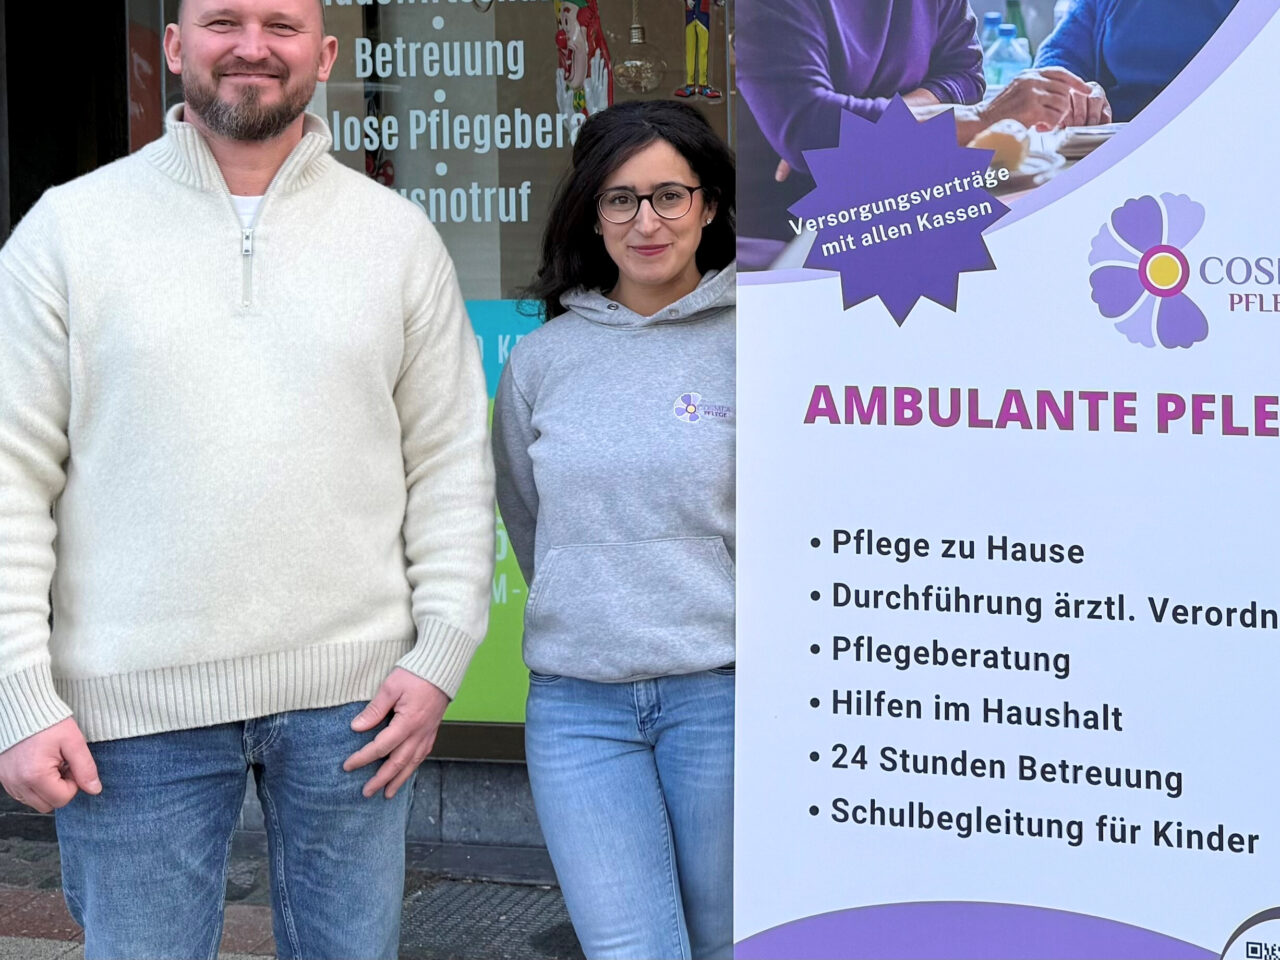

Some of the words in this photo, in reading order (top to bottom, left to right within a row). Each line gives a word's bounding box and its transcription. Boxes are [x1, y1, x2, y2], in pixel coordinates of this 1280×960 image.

[355, 36, 525, 80] Betreuung
[409, 107, 587, 153] Pflegebera
[400, 181, 531, 223] snotruf
[788, 167, 1010, 236] Versorgungsverträge
[821, 232, 857, 257] mit
[861, 221, 913, 247] allen
[915, 200, 993, 231] Kassen
[803, 384, 1138, 433] AMBULANTE
[832, 528, 930, 561] Pflege
[941, 539, 976, 560] zu
[987, 534, 1085, 565] Hause
[832, 582, 1042, 624] Durchführung
[1054, 591, 1135, 622] ärztl.
[832, 635, 1071, 680] Pflegeberatung
[832, 689, 922, 721] Hilfen
[934, 693, 971, 723] im
[982, 697, 1124, 732] Haushalt
[831, 743, 868, 771] 24
[879, 746, 1006, 780] Stunden
[1018, 754, 1184, 799] Betreuung
[831, 797, 1084, 848] Schulbegleitung
[1095, 814, 1142, 845] für
[1153, 819, 1260, 855] Kinder
